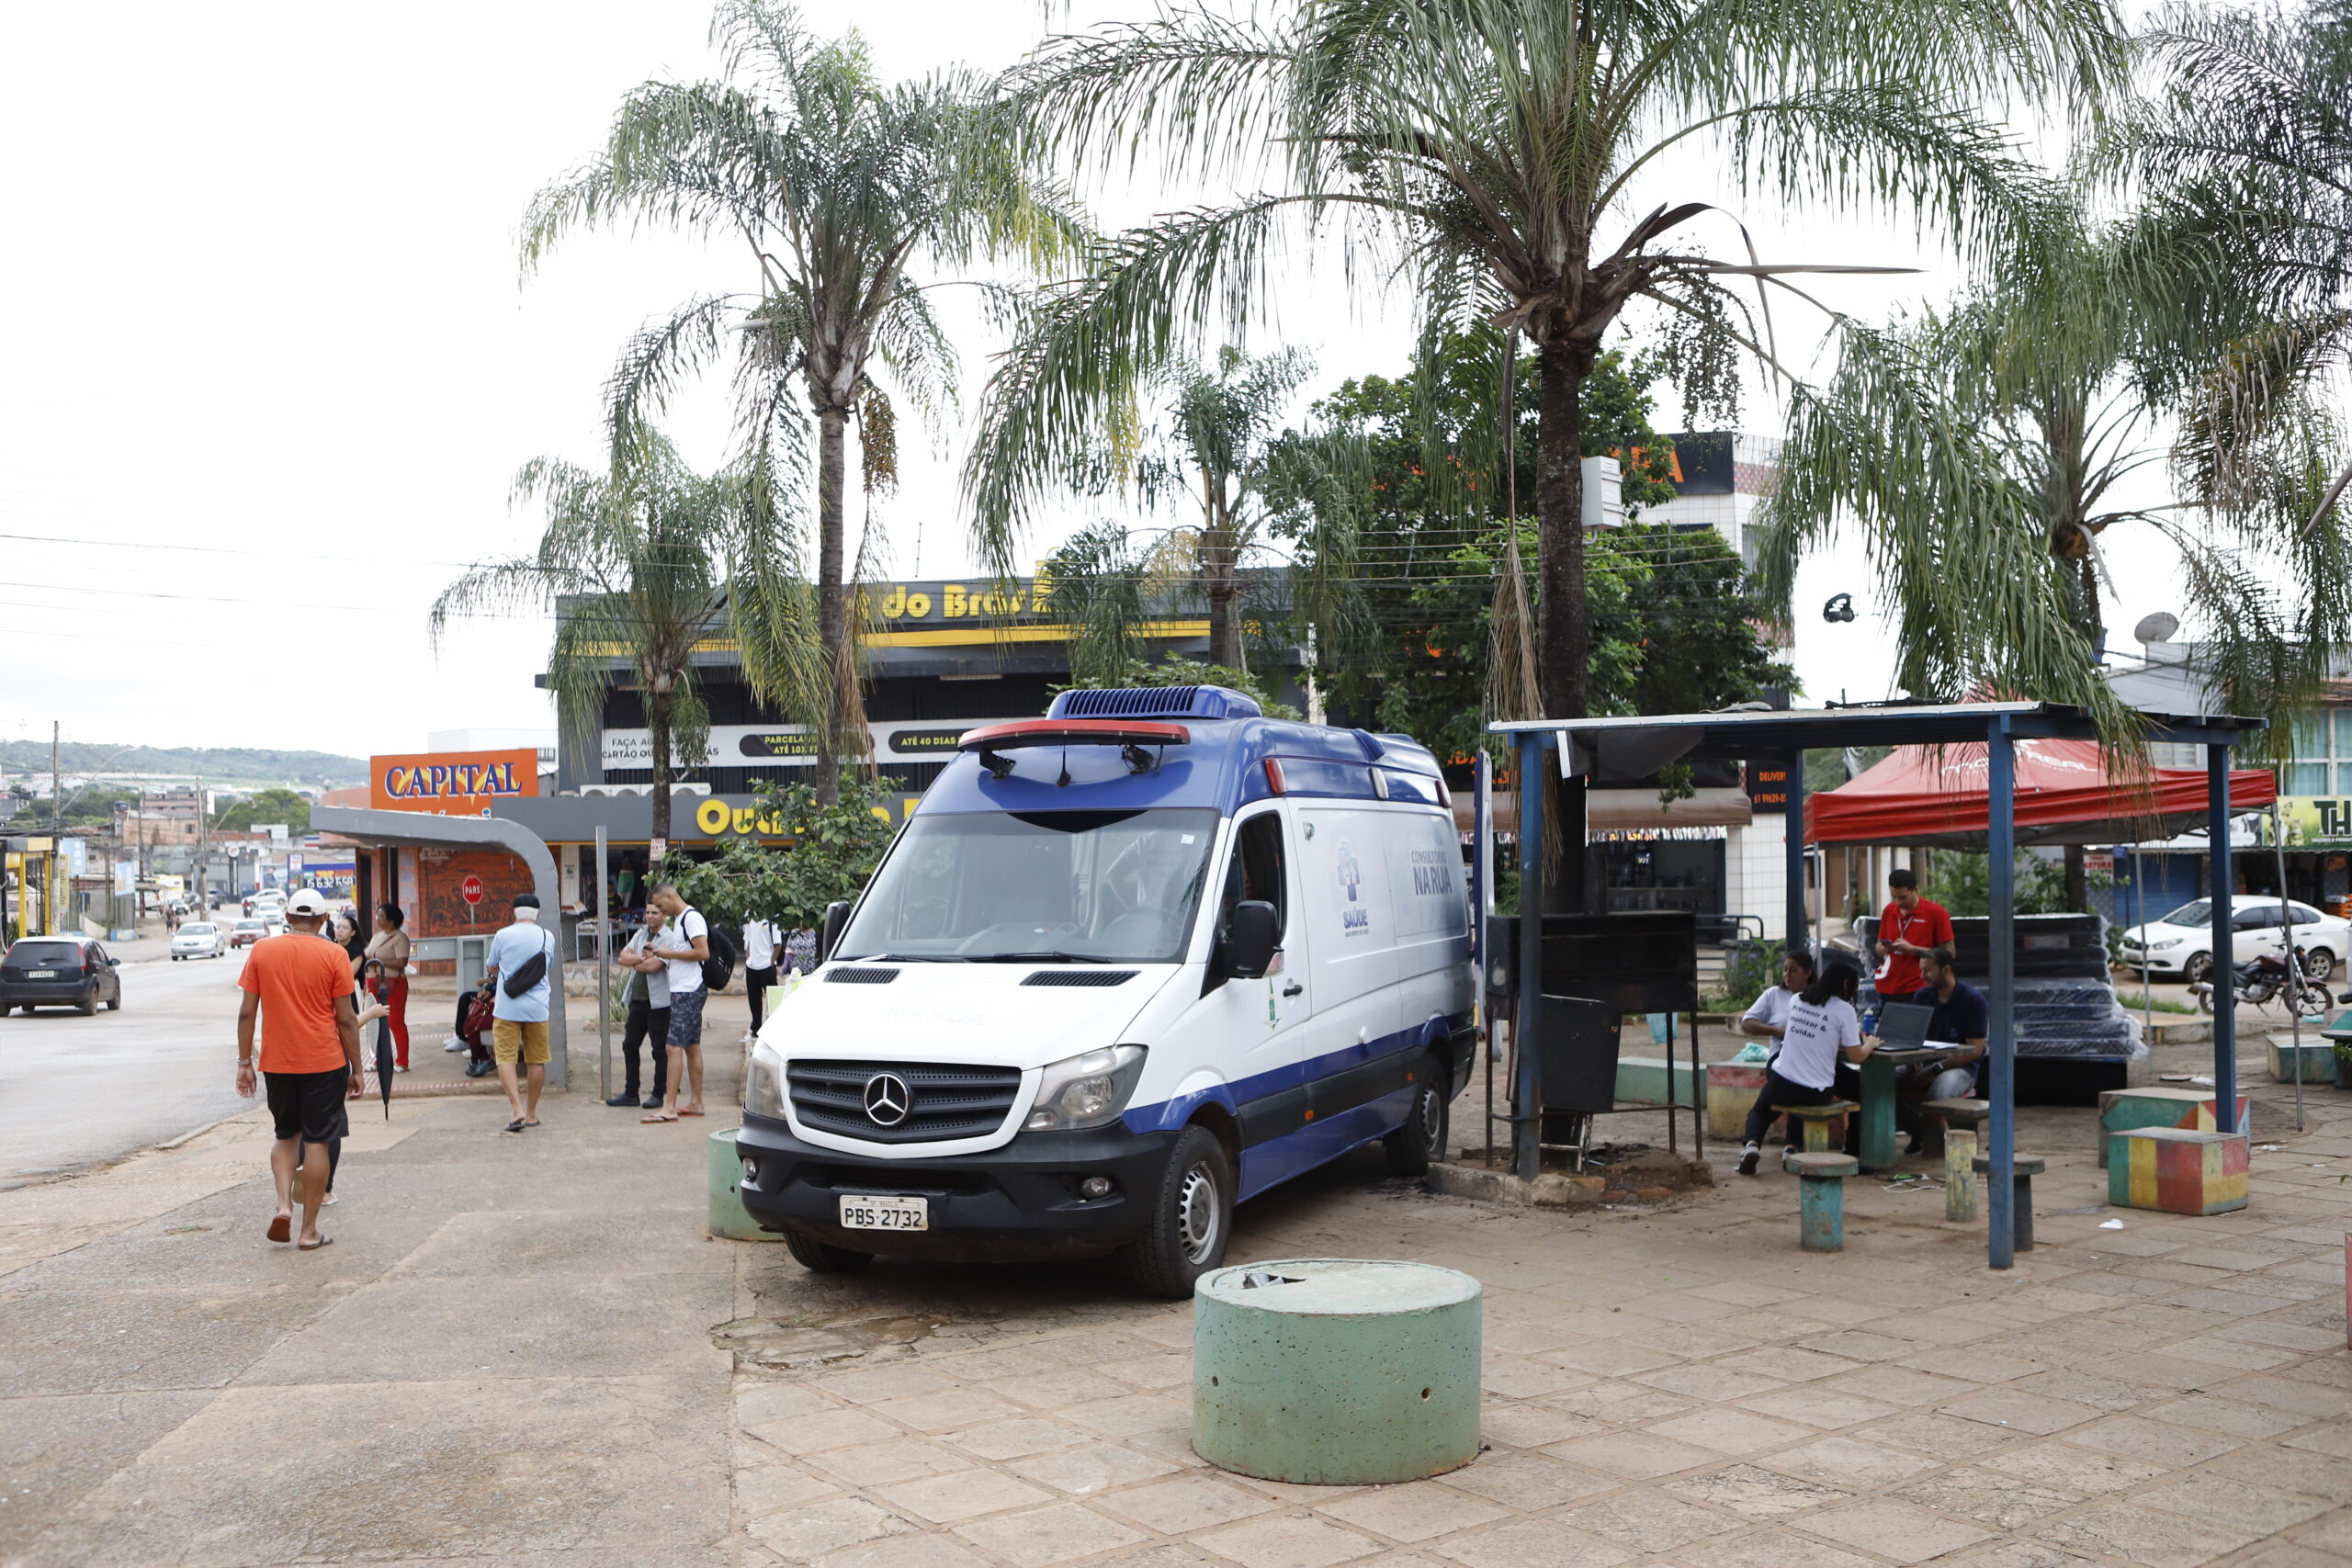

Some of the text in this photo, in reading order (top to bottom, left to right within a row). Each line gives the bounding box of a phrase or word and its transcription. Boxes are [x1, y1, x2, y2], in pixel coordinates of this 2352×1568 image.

[881, 585, 932, 619] do
[612, 738, 637, 750] FAÇA
[901, 736, 918, 746] ATÉ
[933, 737, 956, 745] DIAS
[774, 744, 789, 754] ATÉ
[385, 762, 522, 799] CAPITAL
[1413, 866, 1453, 896] NA RUA
[465, 885, 481, 895] PARE
[1343, 906, 1368, 929] SAÚDE
[1792, 1005, 1820, 1018] Prevenir
[1791, 1026, 1815, 1038] Cuidar
